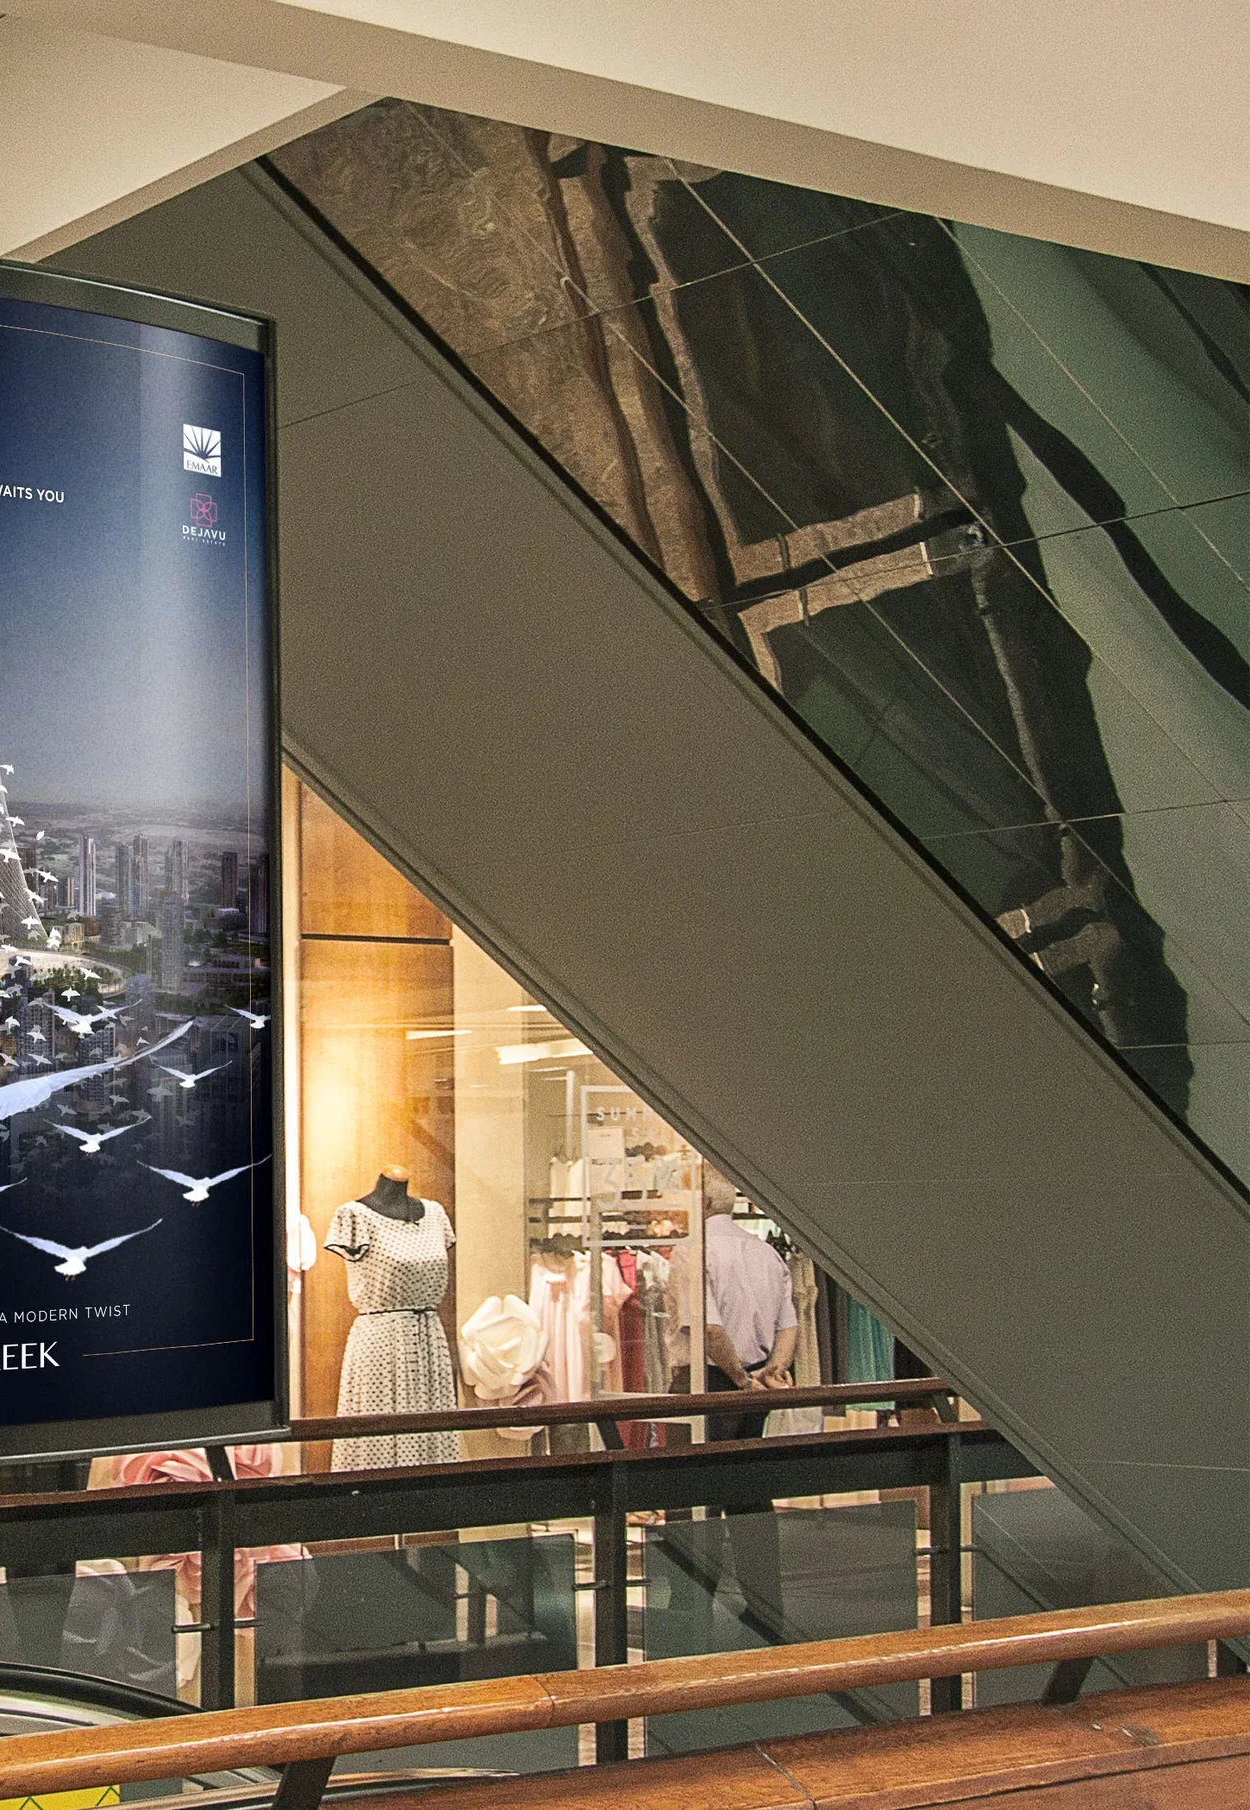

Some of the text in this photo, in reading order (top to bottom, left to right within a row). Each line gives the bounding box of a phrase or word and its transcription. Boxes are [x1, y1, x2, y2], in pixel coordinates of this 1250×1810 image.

[187, 460, 218, 474] EMAAR
[36, 488, 65, 504] YOU
[182, 524, 226, 540] DEJAVU
[14, 1307, 78, 1323] MODERN
[84, 1303, 131, 1319] TWIST
